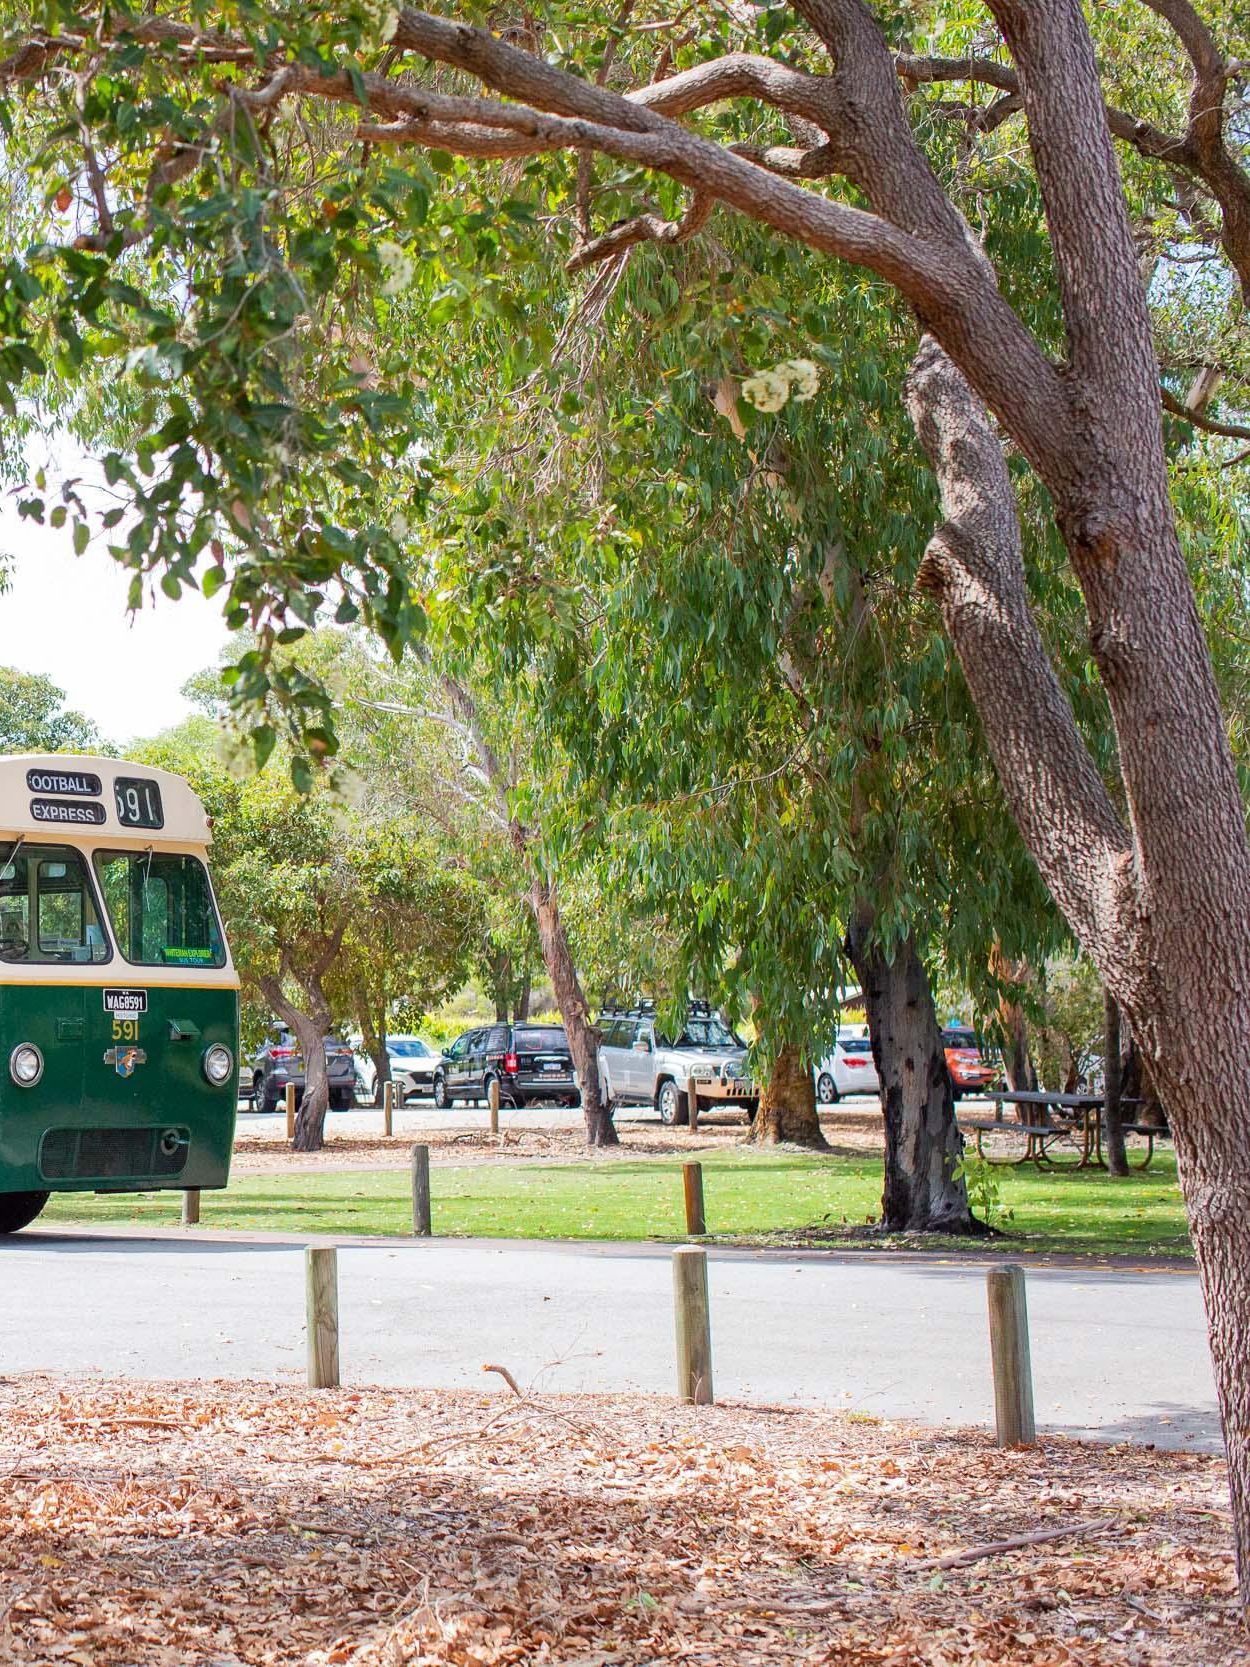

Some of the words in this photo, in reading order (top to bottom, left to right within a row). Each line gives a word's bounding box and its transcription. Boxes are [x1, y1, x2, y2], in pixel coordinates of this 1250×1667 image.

[29, 775, 91, 792] OOTBALL
[33, 804, 95, 821] EXPRESS
[107, 995, 143, 1010] WAG8591
[112, 1020, 139, 1041] 591
